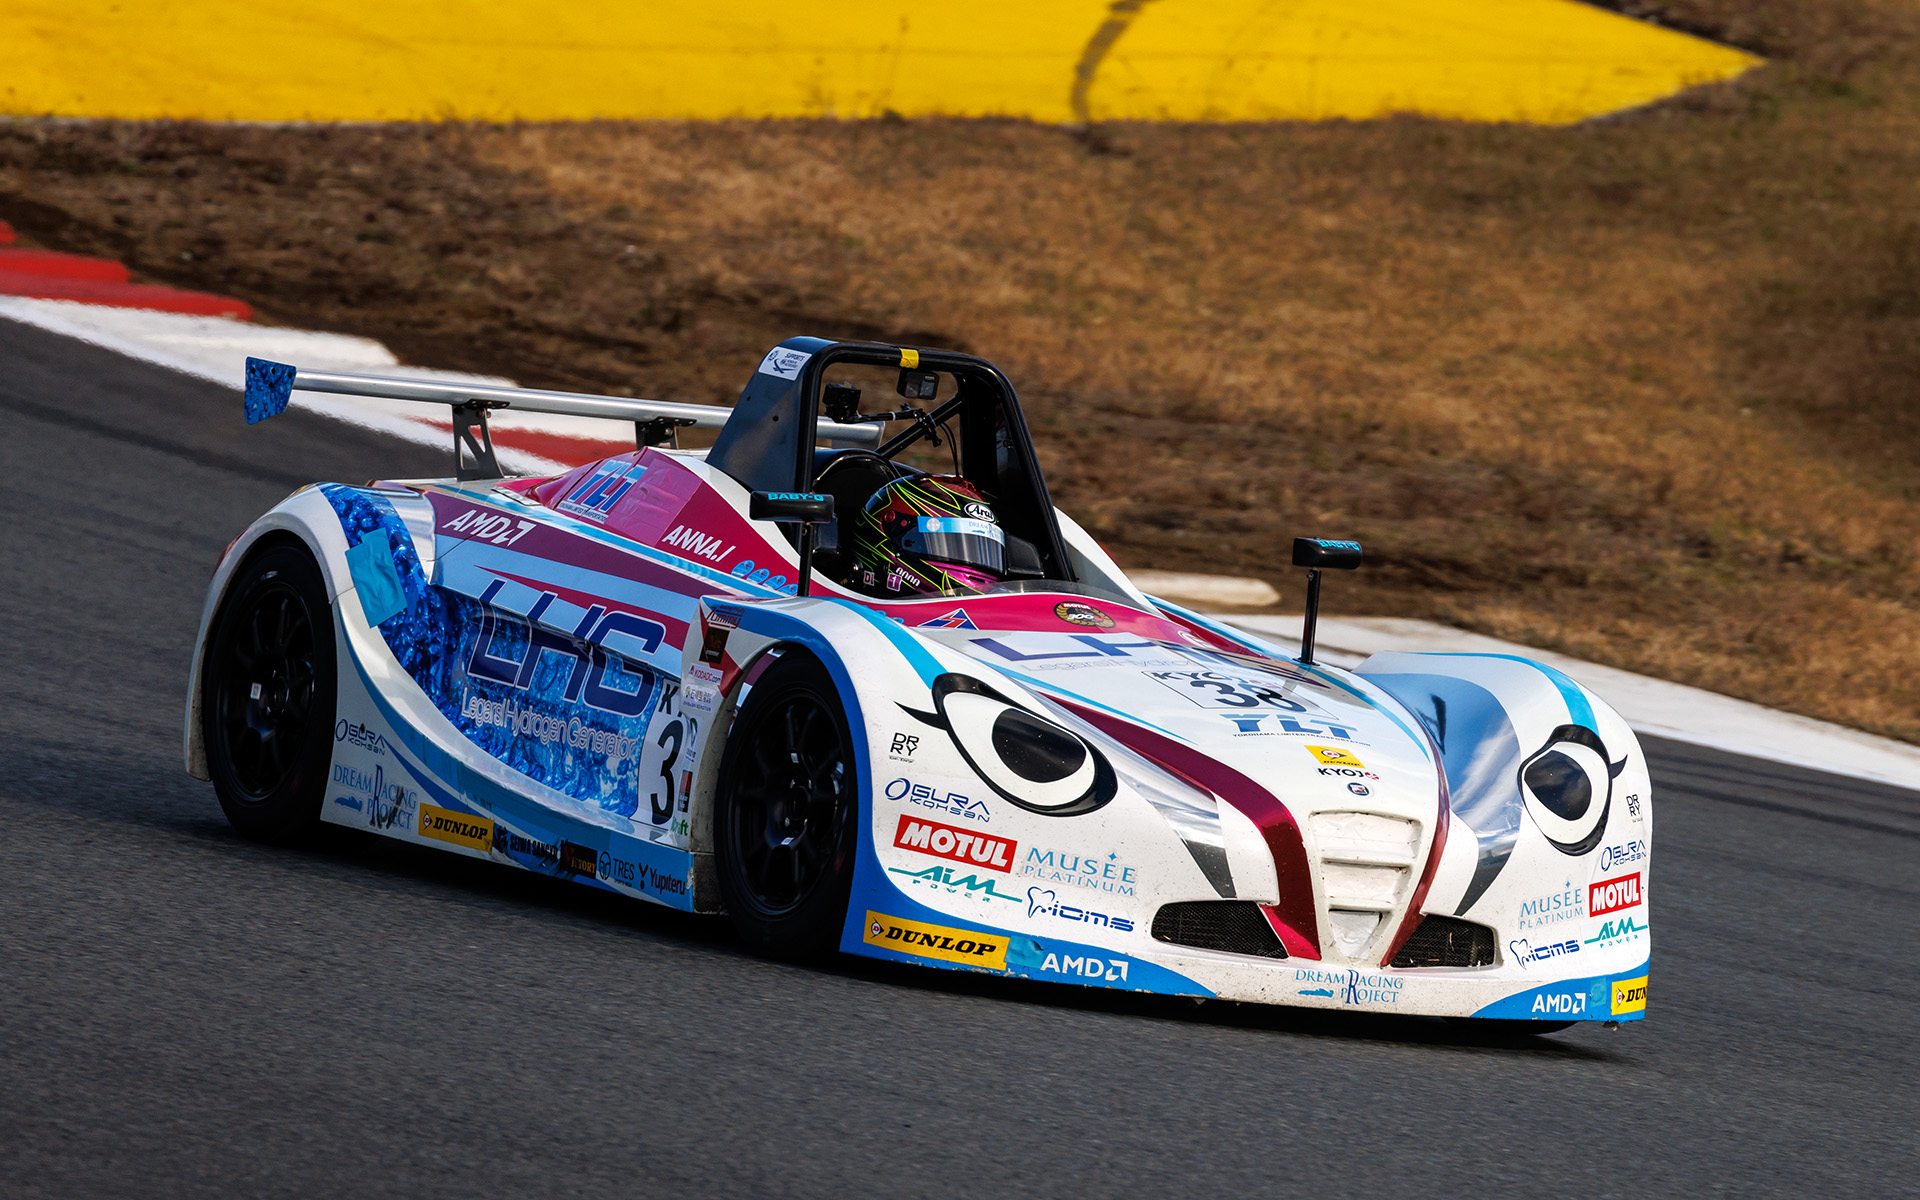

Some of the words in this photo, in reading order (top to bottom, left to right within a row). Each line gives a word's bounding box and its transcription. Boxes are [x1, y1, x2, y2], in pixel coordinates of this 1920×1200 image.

[442, 509, 512, 539] AMD
[970, 504, 994, 520] Arai
[466, 578, 666, 718] LHG
[1190, 680, 1307, 713] 38
[503, 698, 568, 748] Hydrogen
[567, 716, 637, 760] Generator
[1219, 713, 1358, 739] YLT
[333, 763, 373, 794] DREAM
[433, 817, 489, 840] DUNLOP
[899, 820, 1009, 868] MOTUL
[613, 857, 635, 881] TRES
[649, 867, 687, 895] Yupiteru
[1024, 865, 1134, 897] PLATINUM
[1592, 876, 1640, 912] MOTUL
[1519, 906, 1584, 930] PLATINUM
[885, 926, 997, 956] DUNLOP
[1040, 952, 1104, 979] AMD
[1295, 969, 1345, 985] DREAM
[1346, 969, 1404, 990] RACING
[1340, 987, 1400, 1005] PROJECT
[1531, 993, 1572, 1013] AMD
